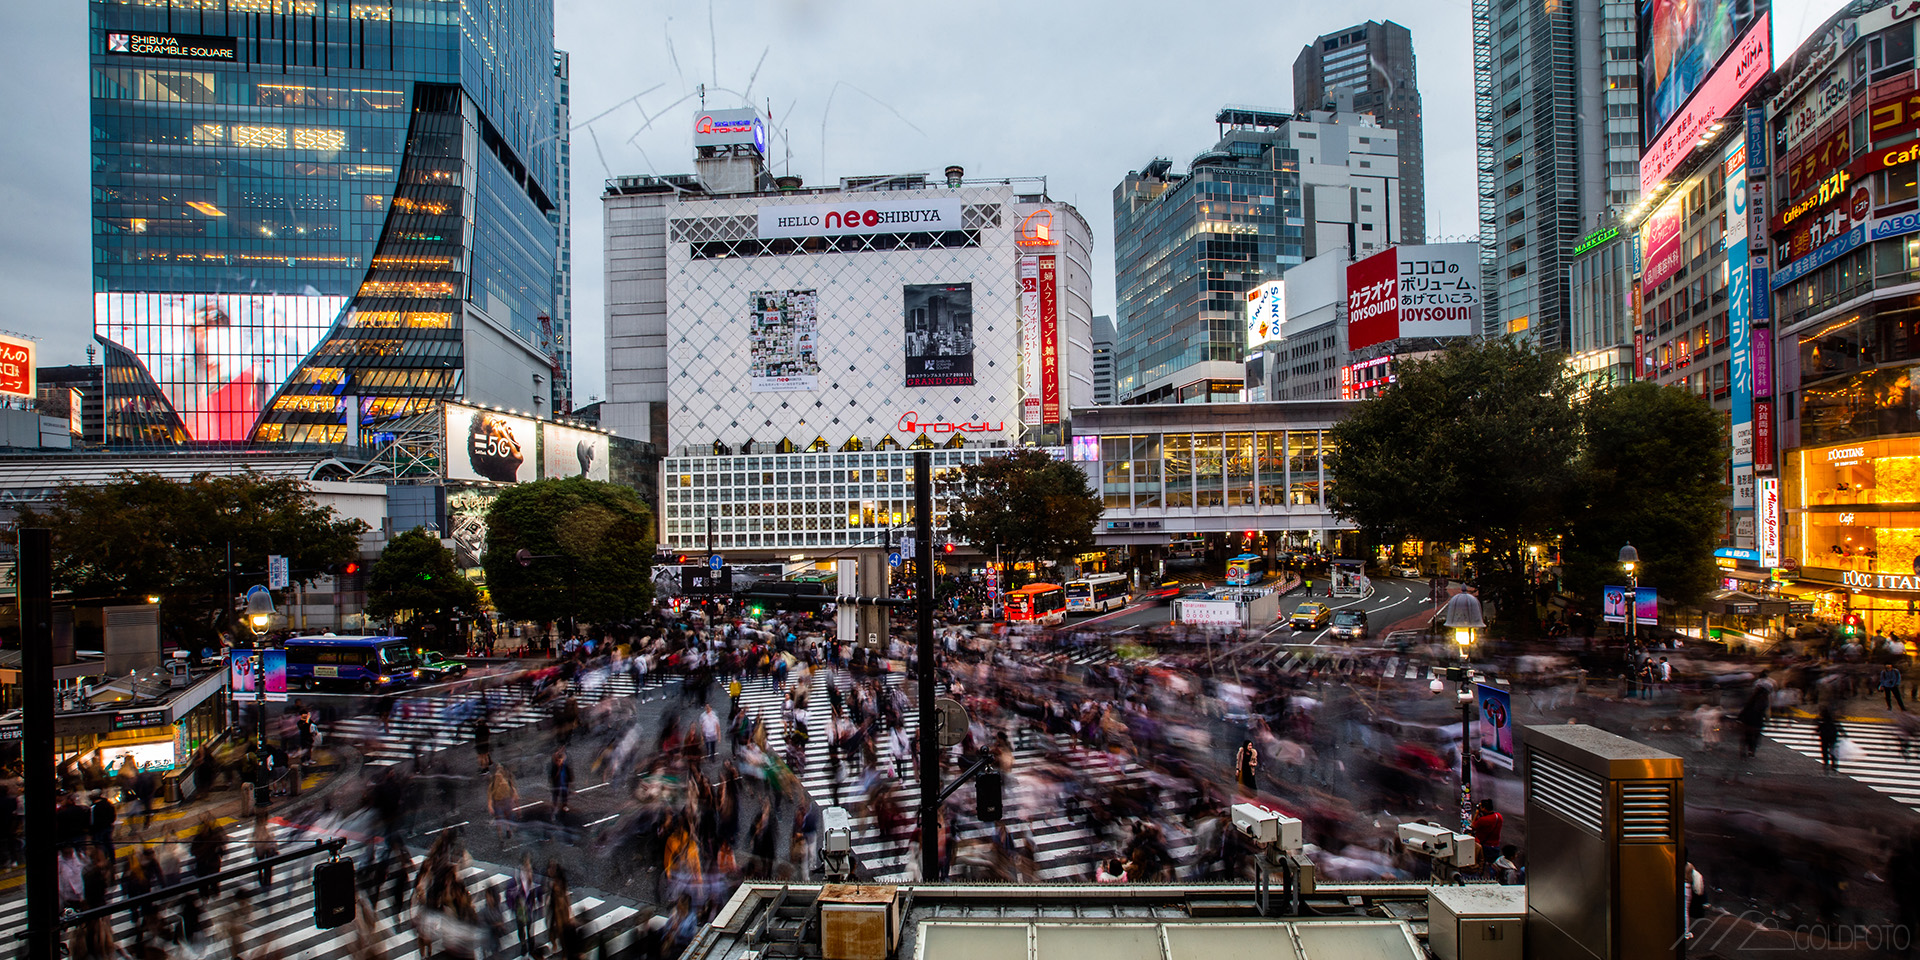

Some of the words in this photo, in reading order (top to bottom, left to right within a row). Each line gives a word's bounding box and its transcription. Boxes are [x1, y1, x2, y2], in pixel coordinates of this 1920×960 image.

[131, 35, 178, 46] SHIBUYA
[131, 44, 188, 55] SCRAMBLE
[190, 47, 233, 58] SQUARE
[1735, 40, 1764, 81] ANIMA
[1677, 125, 1698, 152] Amazon
[1698, 105, 1715, 129] Music
[1777, 126, 1787, 145] 9F
[1791, 129, 1849, 190] プライス
[1883, 144, 1920, 167] Caf
[1819, 169, 1850, 206] ガスト
[778, 215, 820, 228] HELLO
[825, 209, 879, 229] neo
[877, 209, 942, 224] SHIBUYA
[1753, 198, 1763, 241] 献血ルーム
[1810, 208, 1847, 250] ガスト
[1574, 236, 1597, 253] MARK
[1597, 227, 1618, 241] CITY
[1584, 227, 1606, 241] SHIBUYA
[1779, 241, 1791, 261] 7F
[1794, 239, 1848, 276] 英会話イーオン
[1401, 260, 1459, 276] ココロの
[1350, 278, 1396, 309] カラオケ
[1401, 276, 1477, 292] ボリューム、
[1248, 290, 1269, 331] SANKYO
[1270, 286, 1282, 336] SANKYO
[1350, 297, 1398, 324] JOYSOUND
[1402, 292, 1478, 306] あげていこう。
[1731, 264, 1746, 394] アイシティ
[1757, 341, 1767, 385] 品川美容外科
[906, 377, 942, 386] GRAND
[945, 377, 972, 385] OPEN
[916, 421, 1003, 433] TOKYU
[1758, 404, 1768, 437] 外貨両替
[487, 436, 511, 458] 5G
[1839, 513, 1855, 526] Café
[0, 730, 23, 740] 谷駅
